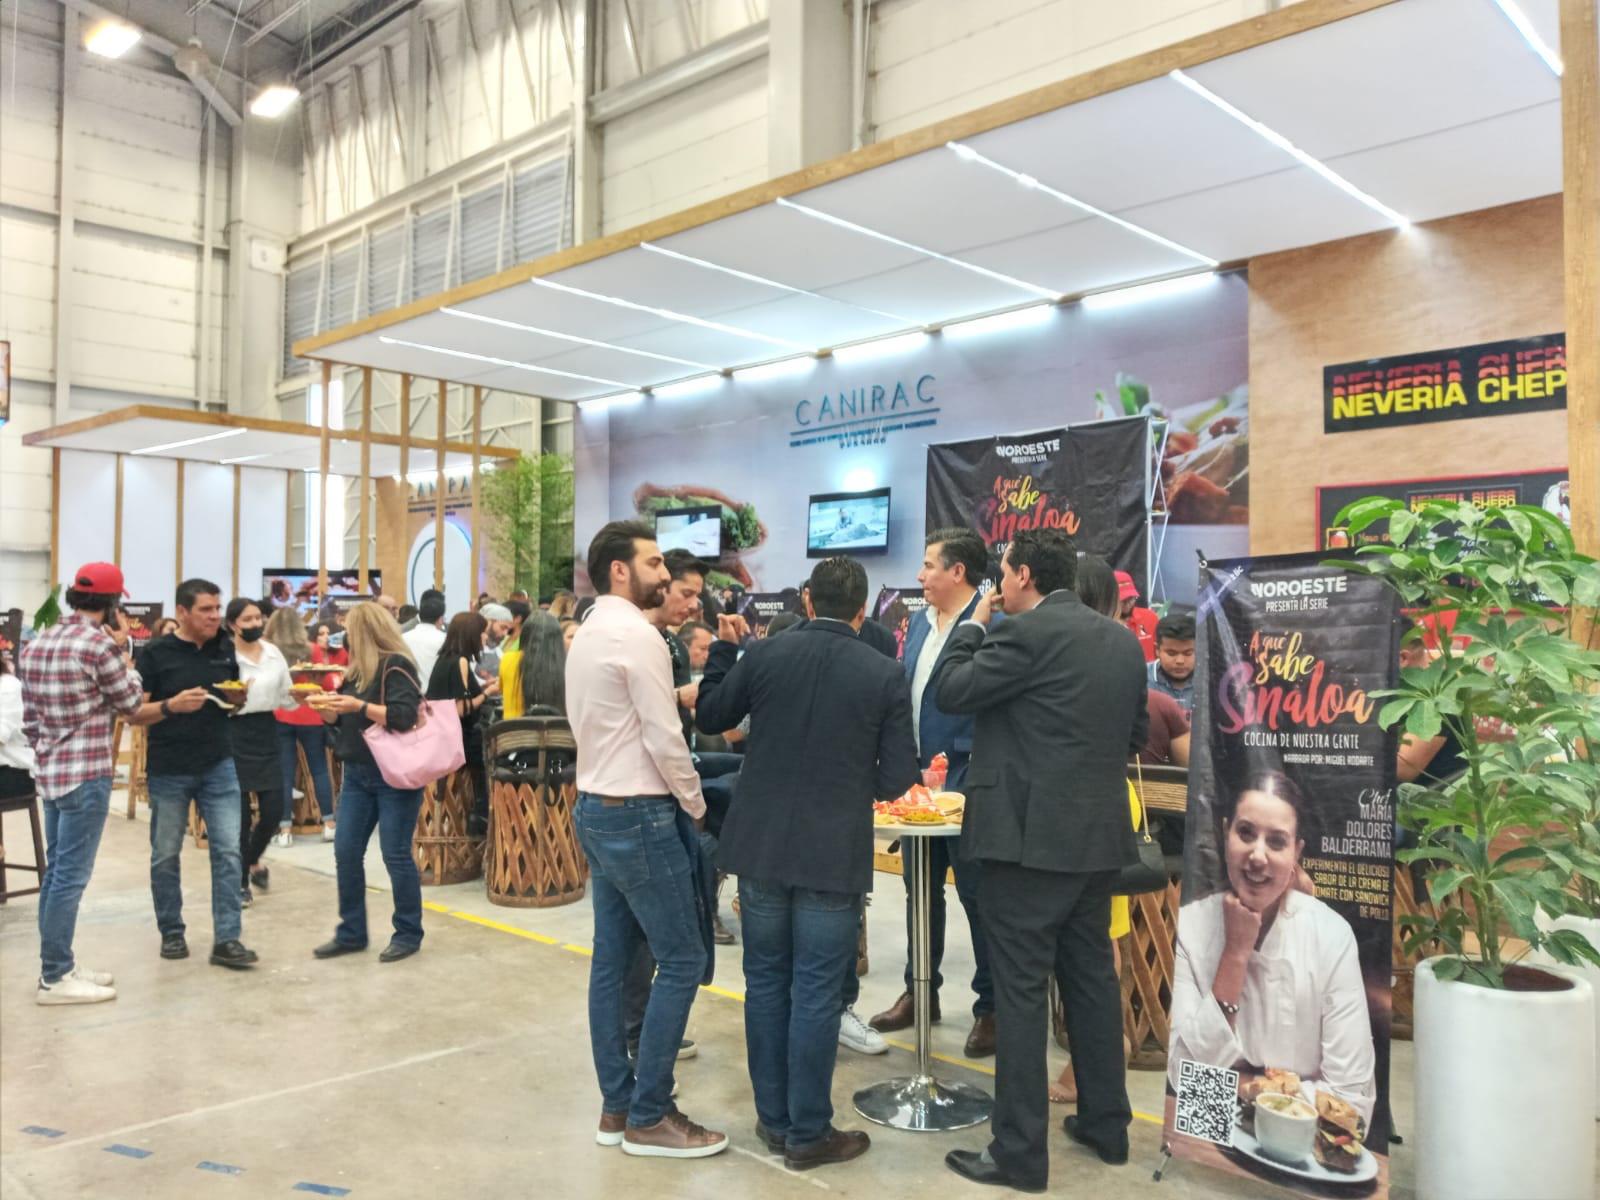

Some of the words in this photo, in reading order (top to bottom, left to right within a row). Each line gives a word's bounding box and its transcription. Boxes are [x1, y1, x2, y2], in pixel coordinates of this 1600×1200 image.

[795, 374, 936, 426] CANIRAC
[1332, 381, 1468, 420] NEVERIA
[1478, 369, 1568, 404] CHEP
[996, 439, 1060, 457] NOROESTE
[998, 475, 1040, 513] sabe
[974, 493, 1081, 545] Sinaloa
[1251, 576, 1347, 597] NOROESTE
[1265, 600, 1299, 613] PRESENTA
[1309, 597, 1329, 610] SERIE
[1249, 631, 1261, 659] A
[1261, 630, 1289, 662] qué
[1256, 632, 1314, 684] sabe
[1218, 660, 1375, 734] Sinaloa
[1244, 731, 1278, 747] COCINA
[1280, 732, 1290, 748] DE
[1293, 732, 1330, 749] NUESTRA
[1333, 733, 1359, 749] GENTE
[1326, 755, 1346, 765] MIGUEL
[1358, 788, 1393, 809] Chef
[1346, 820, 1392, 840] DOLORES
[1322, 836, 1391, 858] BALDERRAMA
[1303, 858, 1347, 872] EXPERIMENTA
[1349, 862, 1355, 874] EL
[1314, 872, 1337, 885] SABOR
[1338, 875, 1347, 887] DE
[1349, 876, 1357, 888] LA
[1359, 877, 1381, 891] CREMA
[1383, 879, 1389, 892] DE
[1340, 889, 1353, 901] CON
[1360, 905, 1368, 918] DE
